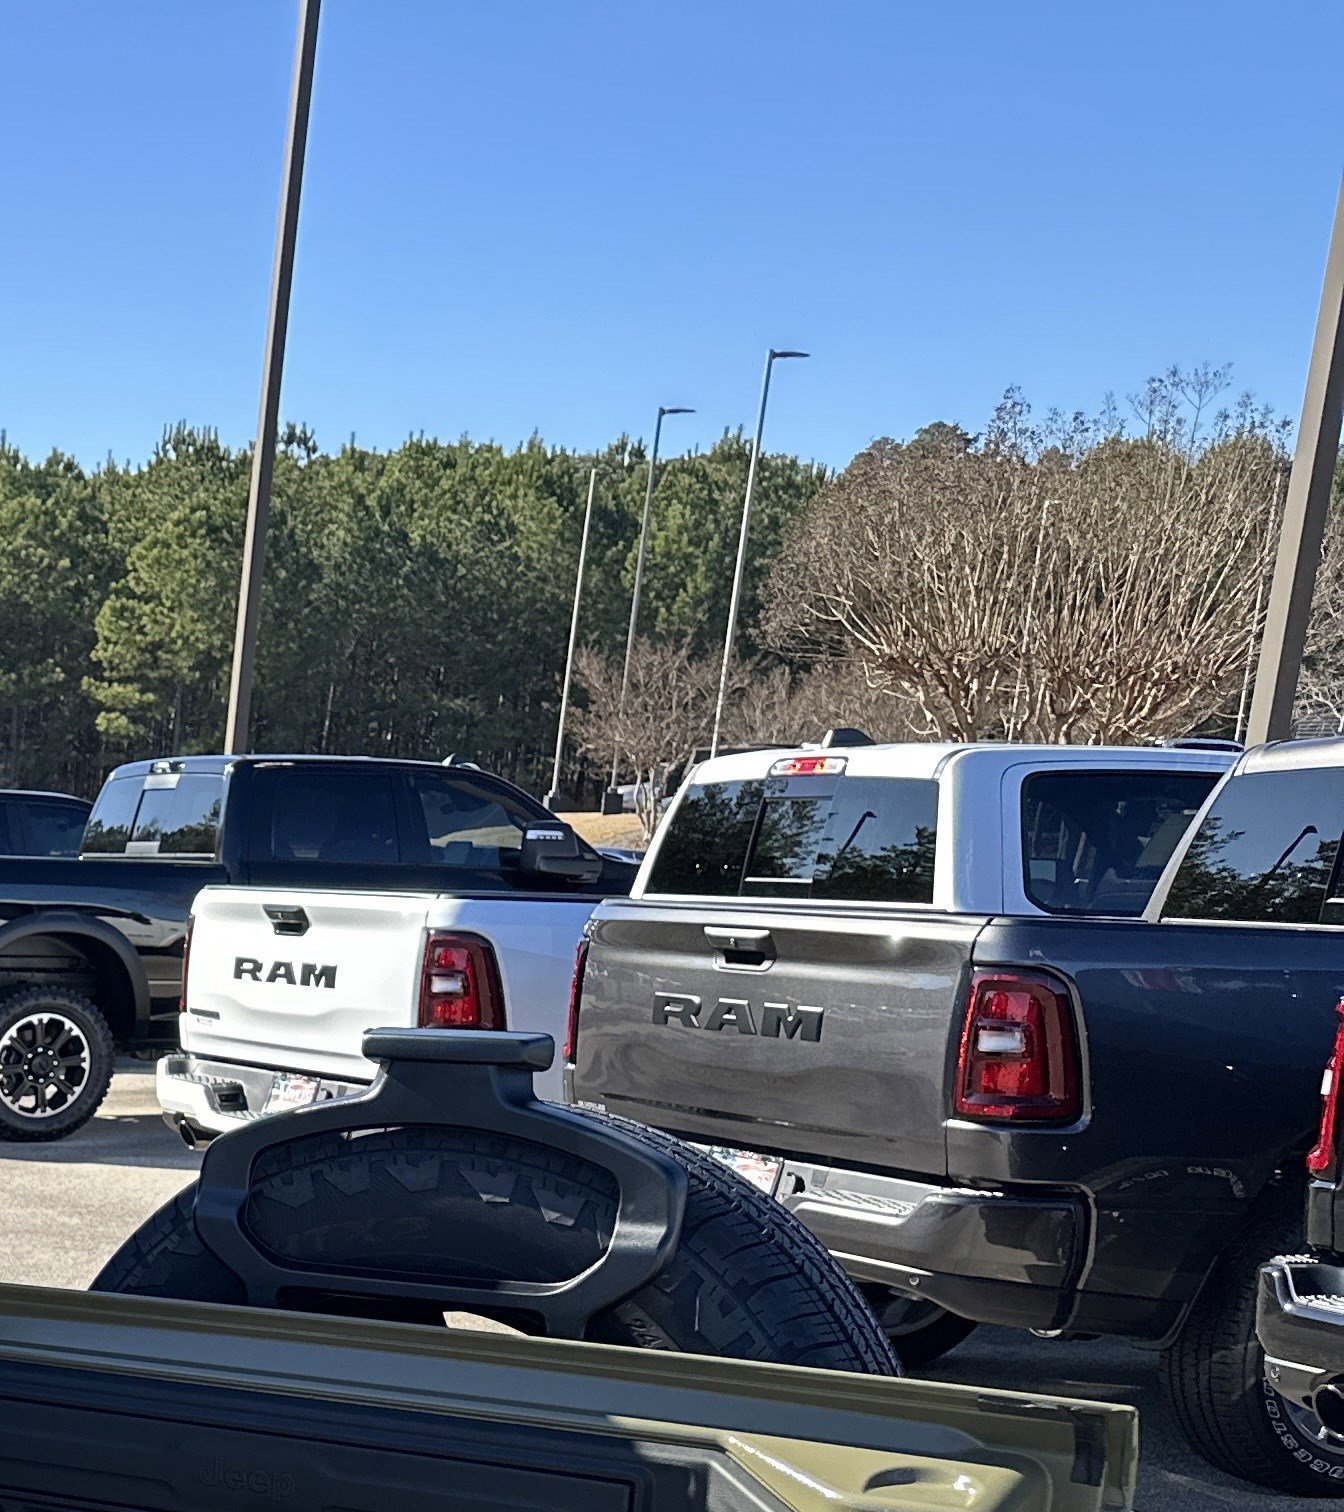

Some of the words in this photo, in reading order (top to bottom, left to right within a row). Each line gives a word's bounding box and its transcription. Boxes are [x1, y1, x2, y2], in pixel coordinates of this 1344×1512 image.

[233, 956, 338, 989] RAM
[652, 991, 825, 1043] RAM
[194, 1456, 296, 1502] Jeep
